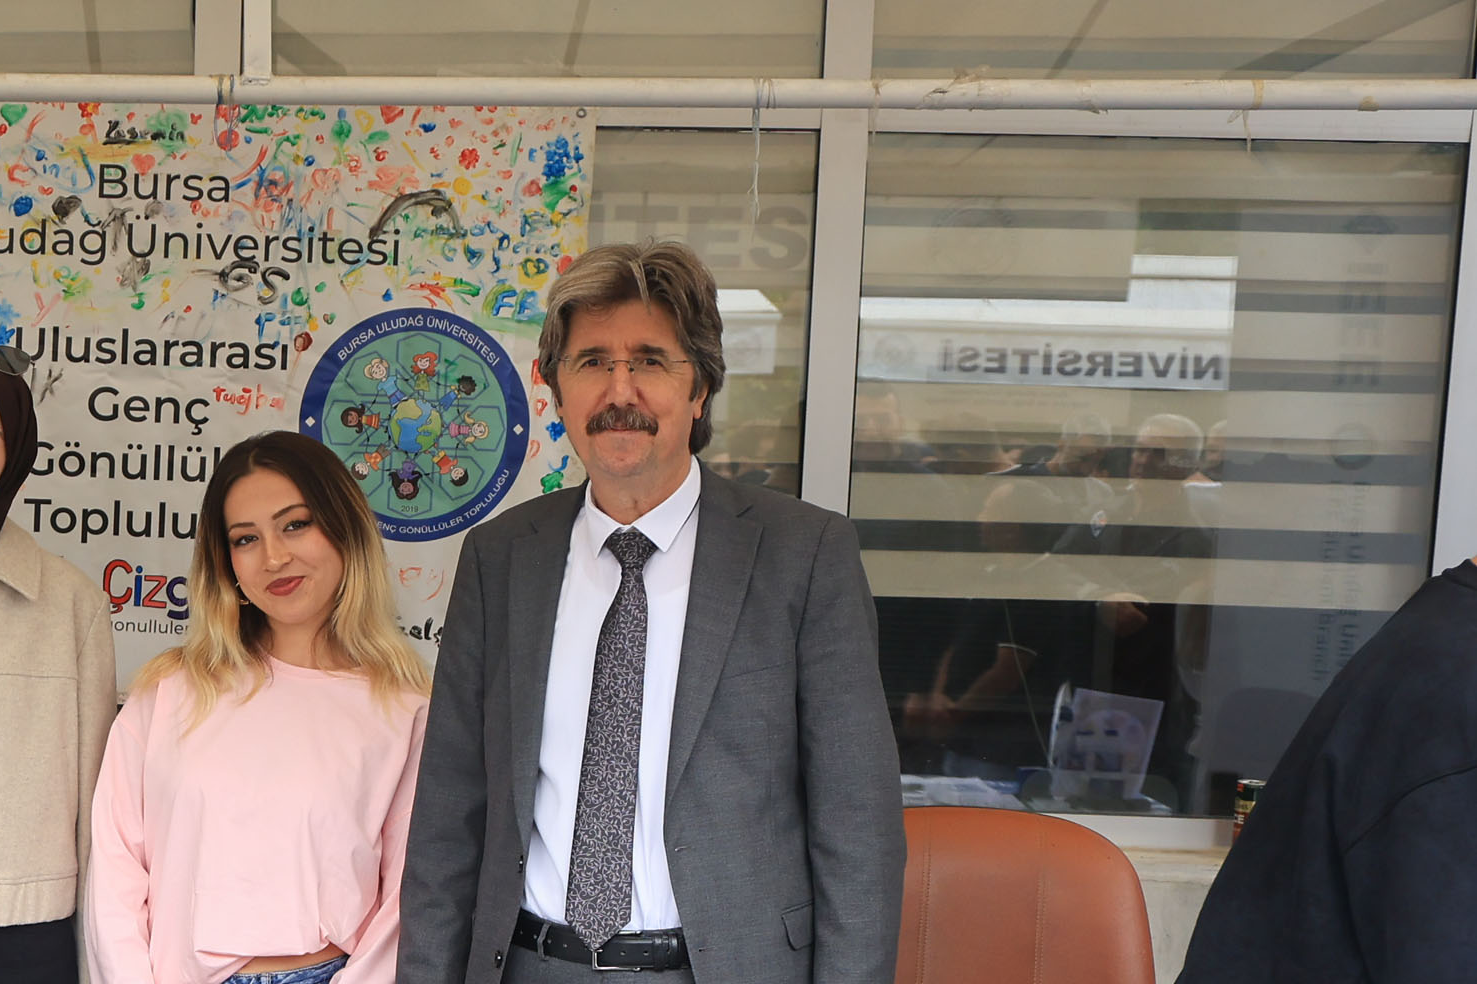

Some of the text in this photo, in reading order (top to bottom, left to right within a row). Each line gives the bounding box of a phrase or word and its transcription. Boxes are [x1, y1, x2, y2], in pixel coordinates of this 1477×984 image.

[99, 163, 231, 203] Bursa
[127, 215, 401, 266] Üniversitesi
[16, 326, 289, 371] Uluslararası
[337, 314, 501, 367] BURSA ULUDAĞ ÜNİVERSİTESİ
[88, 387, 211, 436] Genç
